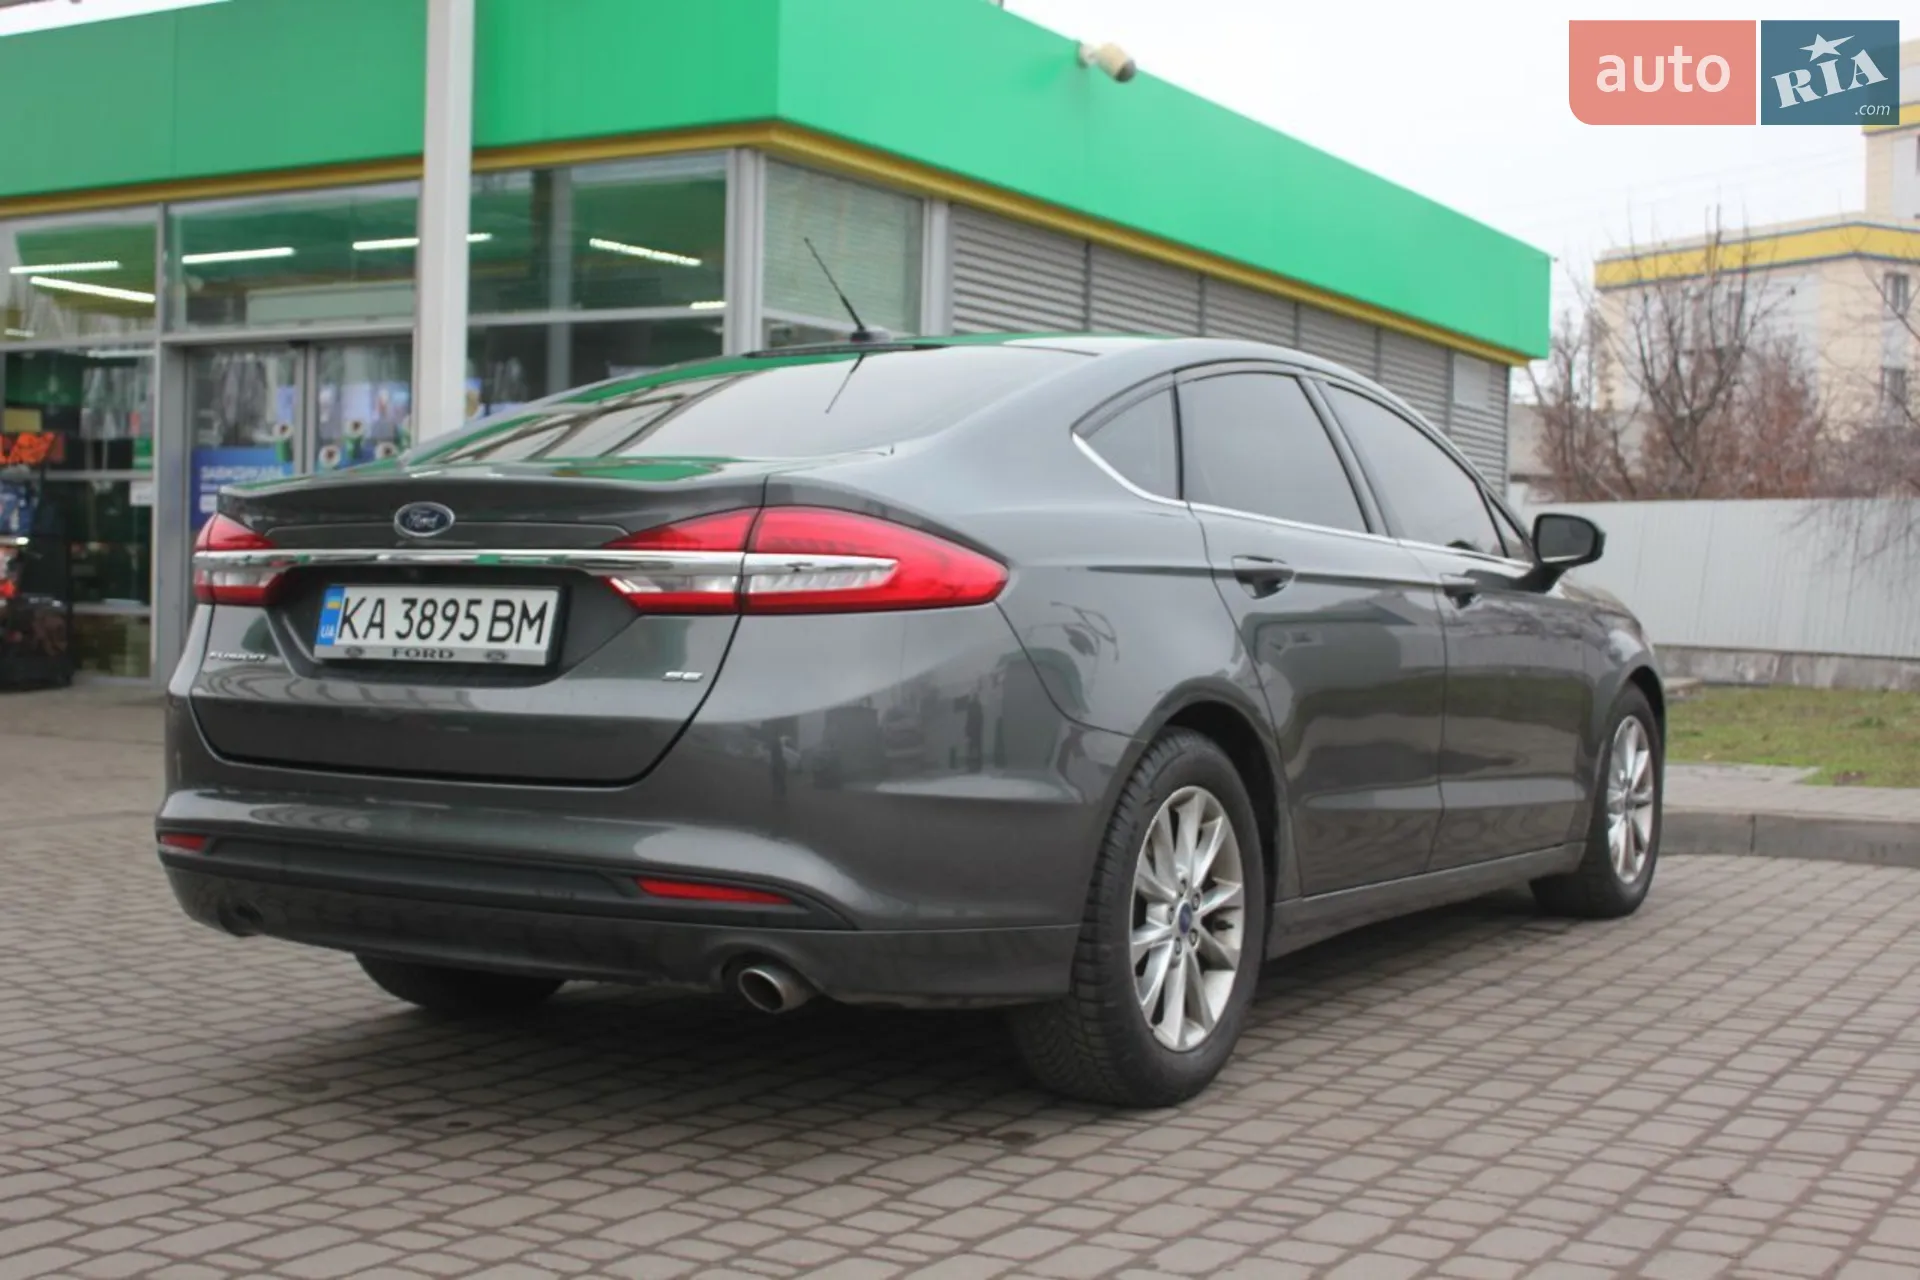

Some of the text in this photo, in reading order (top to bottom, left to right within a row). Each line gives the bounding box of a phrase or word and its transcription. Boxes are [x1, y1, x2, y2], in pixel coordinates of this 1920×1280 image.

[406, 509, 440, 529] Ford
[338, 597, 548, 645] KA 3895 BM
[320, 625, 335, 637] UA
[392, 647, 454, 660] FORD
